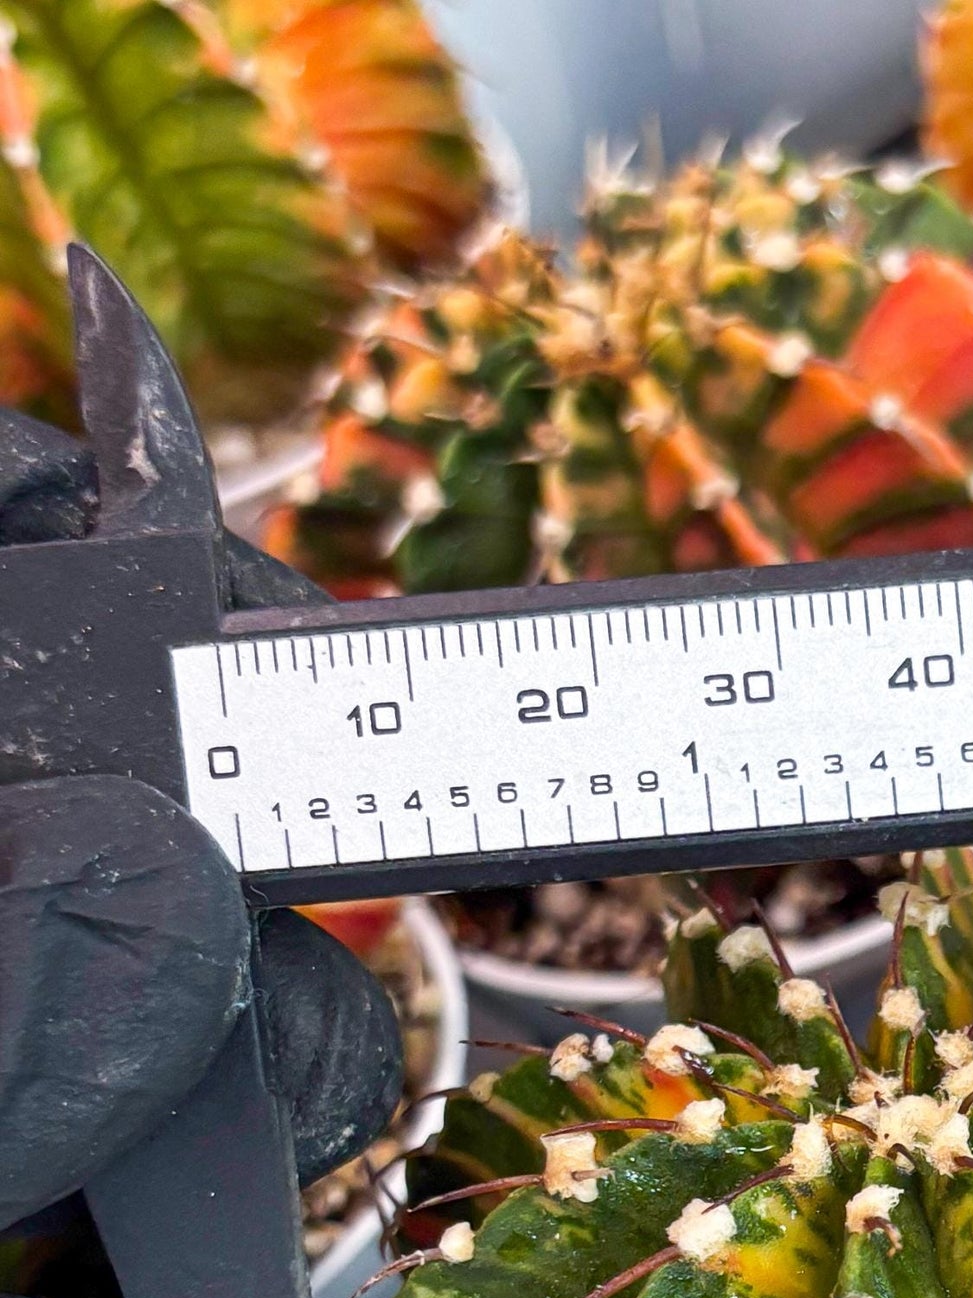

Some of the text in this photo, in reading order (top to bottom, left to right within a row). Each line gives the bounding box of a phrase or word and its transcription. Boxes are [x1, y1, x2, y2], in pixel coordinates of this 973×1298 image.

[208, 746, 240, 779] 0
[347, 702, 401, 737] 10
[517, 686, 589, 723] 20
[704, 671, 775, 706] 30
[888, 654, 955, 690] 40
[271, 803, 282, 822] 1
[309, 798, 330, 819] 2
[356, 794, 377, 813] 3
[404, 790, 423, 811] 4
[450, 786, 470, 807] 5
[497, 782, 517, 803] 6
[548, 778, 565, 798] 7
[590, 774, 613, 795] 8
[637, 771, 659, 792] 9
[682, 741, 698, 774] 1
[740, 763, 750, 782] 1
[777, 758, 798, 779] 2
[823, 754, 844, 774] 3
[870, 751, 888, 771] 4
[915, 746, 934, 767] 5
